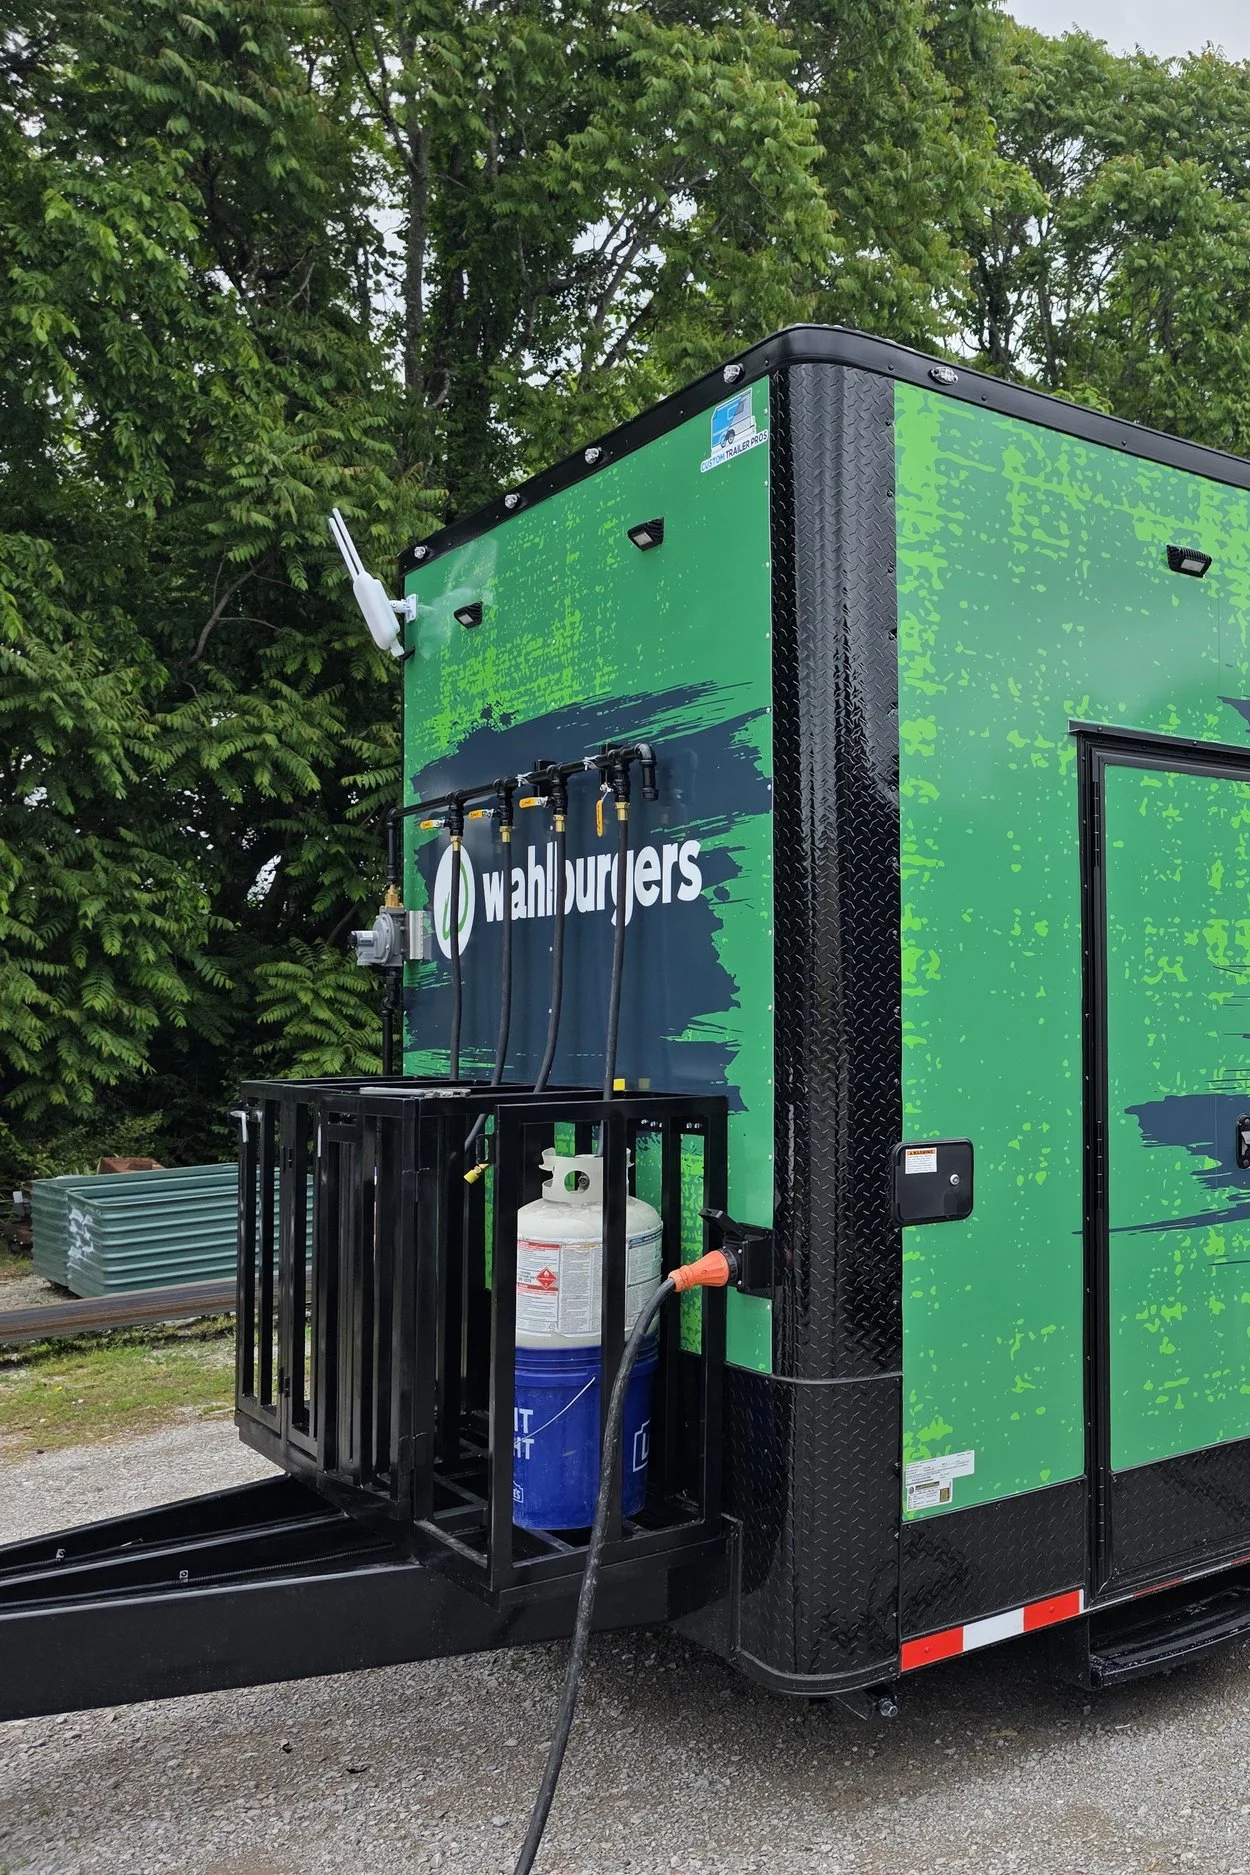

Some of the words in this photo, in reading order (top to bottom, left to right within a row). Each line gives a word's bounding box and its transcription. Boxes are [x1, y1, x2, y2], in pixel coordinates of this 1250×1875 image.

[702, 453, 725, 471] CUSTOM
[726, 440, 750, 459] TRAILER
[751, 431, 767, 446] PROS
